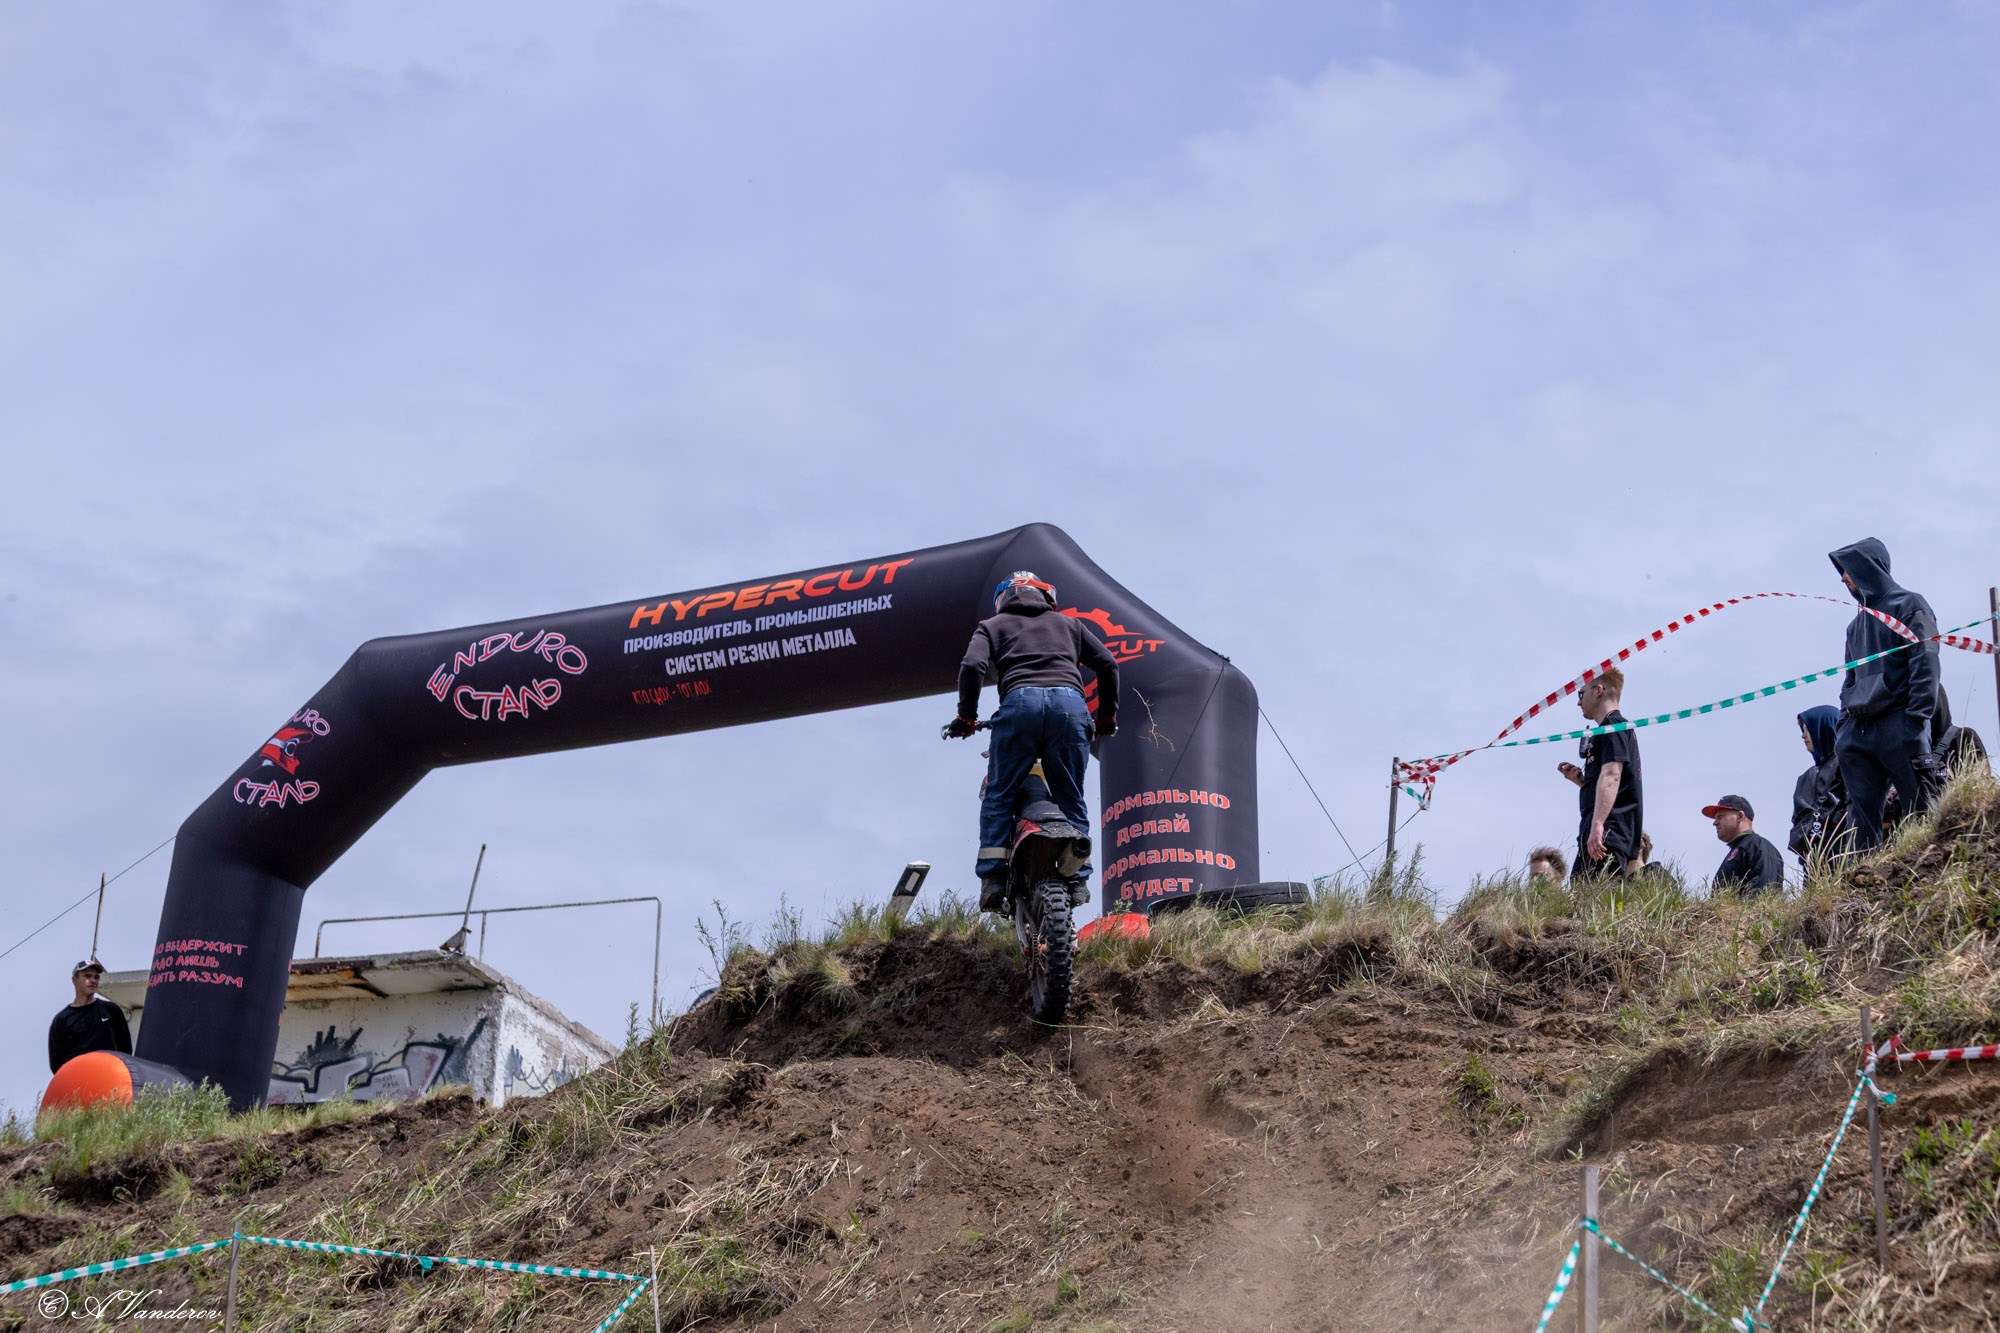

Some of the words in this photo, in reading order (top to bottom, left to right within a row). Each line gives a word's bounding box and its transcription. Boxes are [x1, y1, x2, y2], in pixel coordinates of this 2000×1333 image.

[629, 558, 915, 629] HYPERCUT
[623, 619, 752, 654] ПРОИЗВОДИТЕЛЬ
[755, 594, 893, 632] ПРОМЫШЛЕННЫХ
[426, 629, 588, 702] ENDURO
[664, 649, 727, 676] СИСТЕМ
[728, 639, 781, 666] РЕЗКИ
[781, 627, 857, 657] МЕТАЛЛА
[1116, 813, 1190, 847] делай
[1120, 877, 1194, 900] будет
[165, 939, 248, 956] ВЫДЕРЖИТ
[175, 955, 220, 968] ЛИШЬ
[178, 970, 244, 988] РАЗУМ
